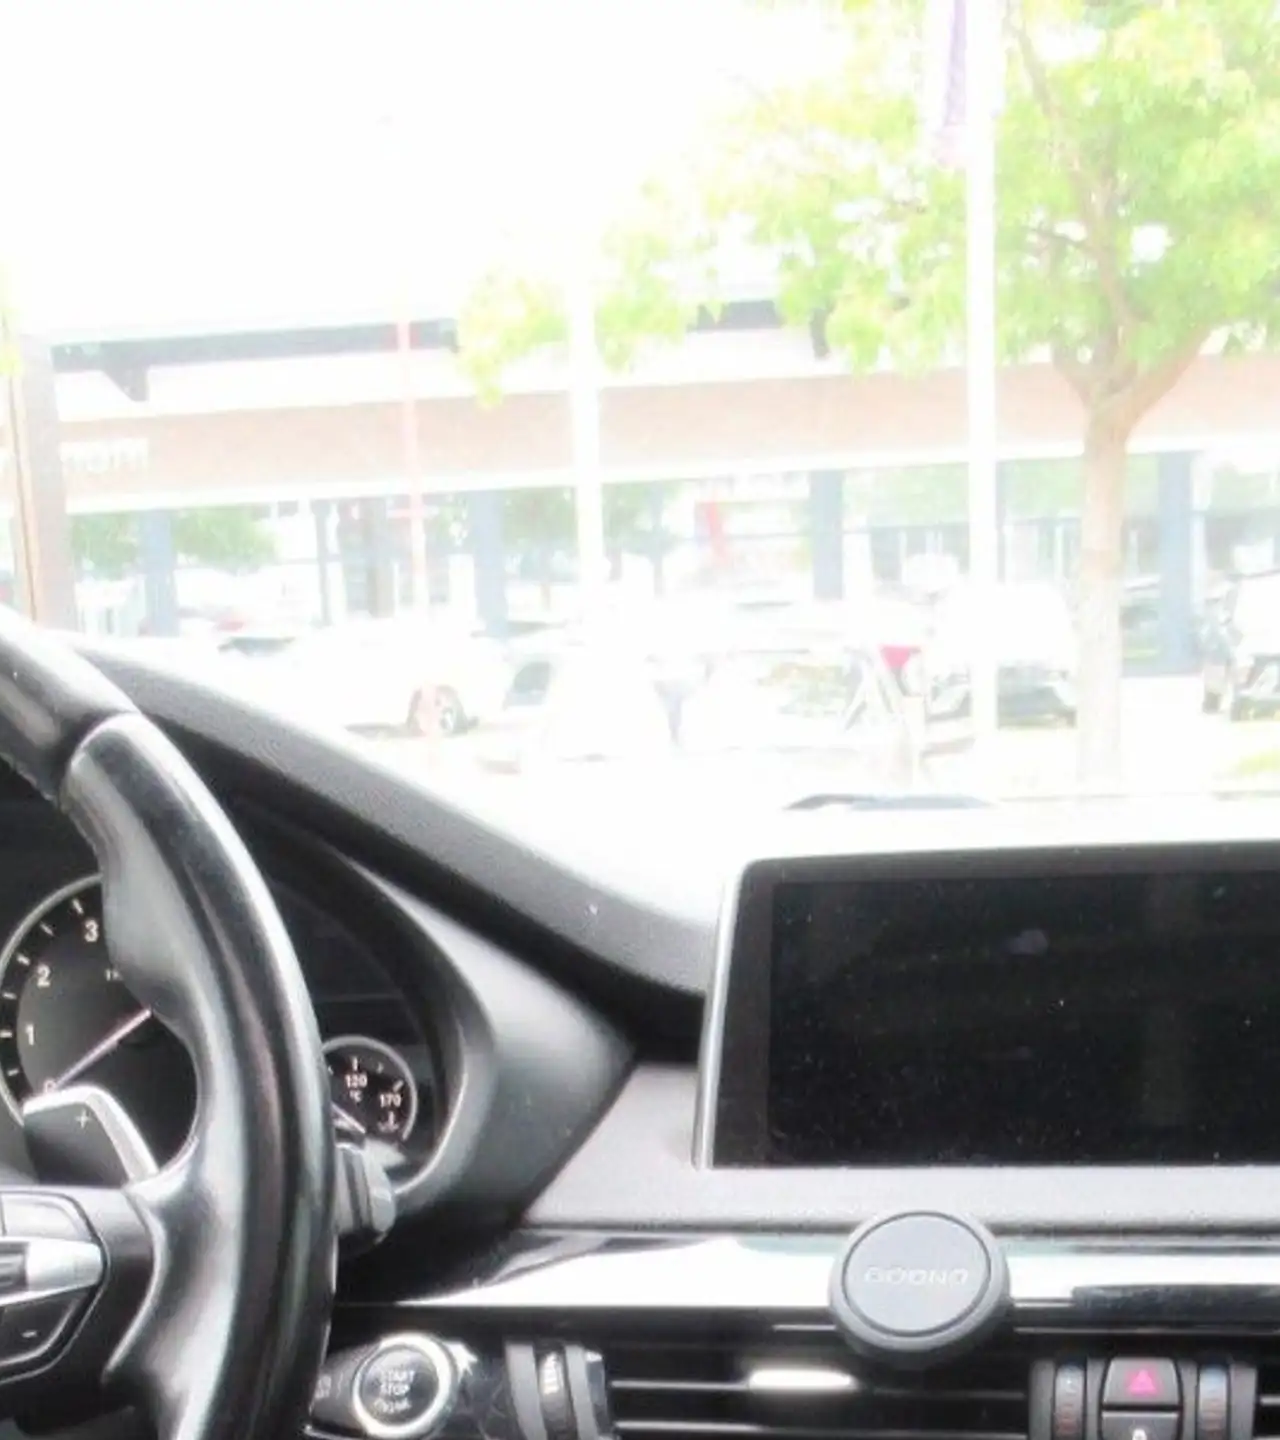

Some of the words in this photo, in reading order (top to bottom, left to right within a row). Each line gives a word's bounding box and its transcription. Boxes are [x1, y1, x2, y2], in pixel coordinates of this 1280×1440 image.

[84, 920, 99, 942] 3
[37, 965, 51, 987] 2
[25, 1024, 34, 1046] 1
[380, 1093, 401, 1108] 170
